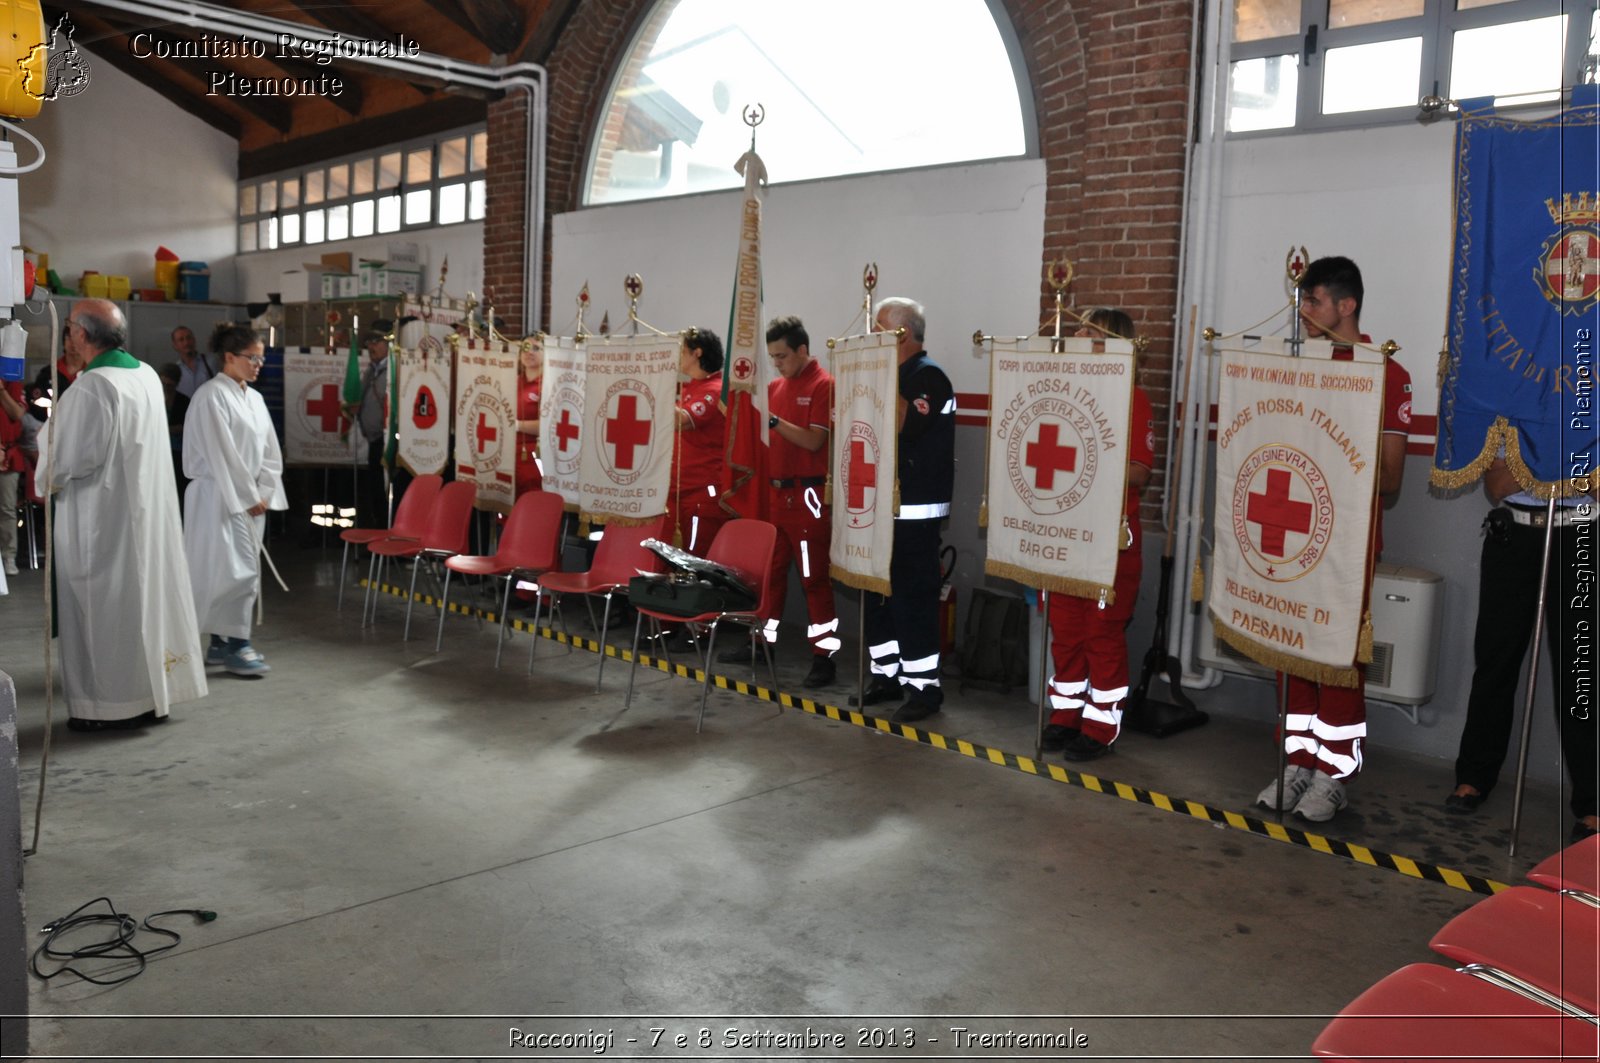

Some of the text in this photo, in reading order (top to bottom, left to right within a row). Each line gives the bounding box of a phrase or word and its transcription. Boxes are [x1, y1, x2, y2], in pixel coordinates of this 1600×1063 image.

[744, 199, 760, 241] CUNEO
[736, 291, 757, 348] COMITATO
[635, 352, 648, 362] DEL
[1062, 362, 1077, 374] DEL
[1080, 362, 1125, 376] SOCCORSO
[1251, 366, 1297, 386] VOLONTARI
[1299, 372, 1317, 389] DEL
[1320, 375, 1374, 393] SOCCORSO
[997, 378, 1116, 451] CROCE ROSSA ITALIANA
[1020, 414, 1031, 426] DI
[1032, 400, 1074, 419] GINEVRA
[1074, 416, 1090, 433] 22
[1220, 407, 1253, 449] CROCE
[1256, 399, 1304, 416] ROSSA
[1310, 408, 1367, 475] ITALIANA
[1080, 437, 1097, 489] AGOSTO
[647, 488, 657, 498] DI
[1056, 490, 1082, 509] 1864
[1234, 449, 1331, 569] CONVENZIONE DI GINEVRA 22 AGOSTO 1864
[1003, 516, 1094, 543] DELEGAZIONE DI
[1020, 539, 1068, 561] BARGE
[1225, 578, 1330, 626] DELEGAZIONE DI
[1232, 608, 1304, 650] PAESANA
